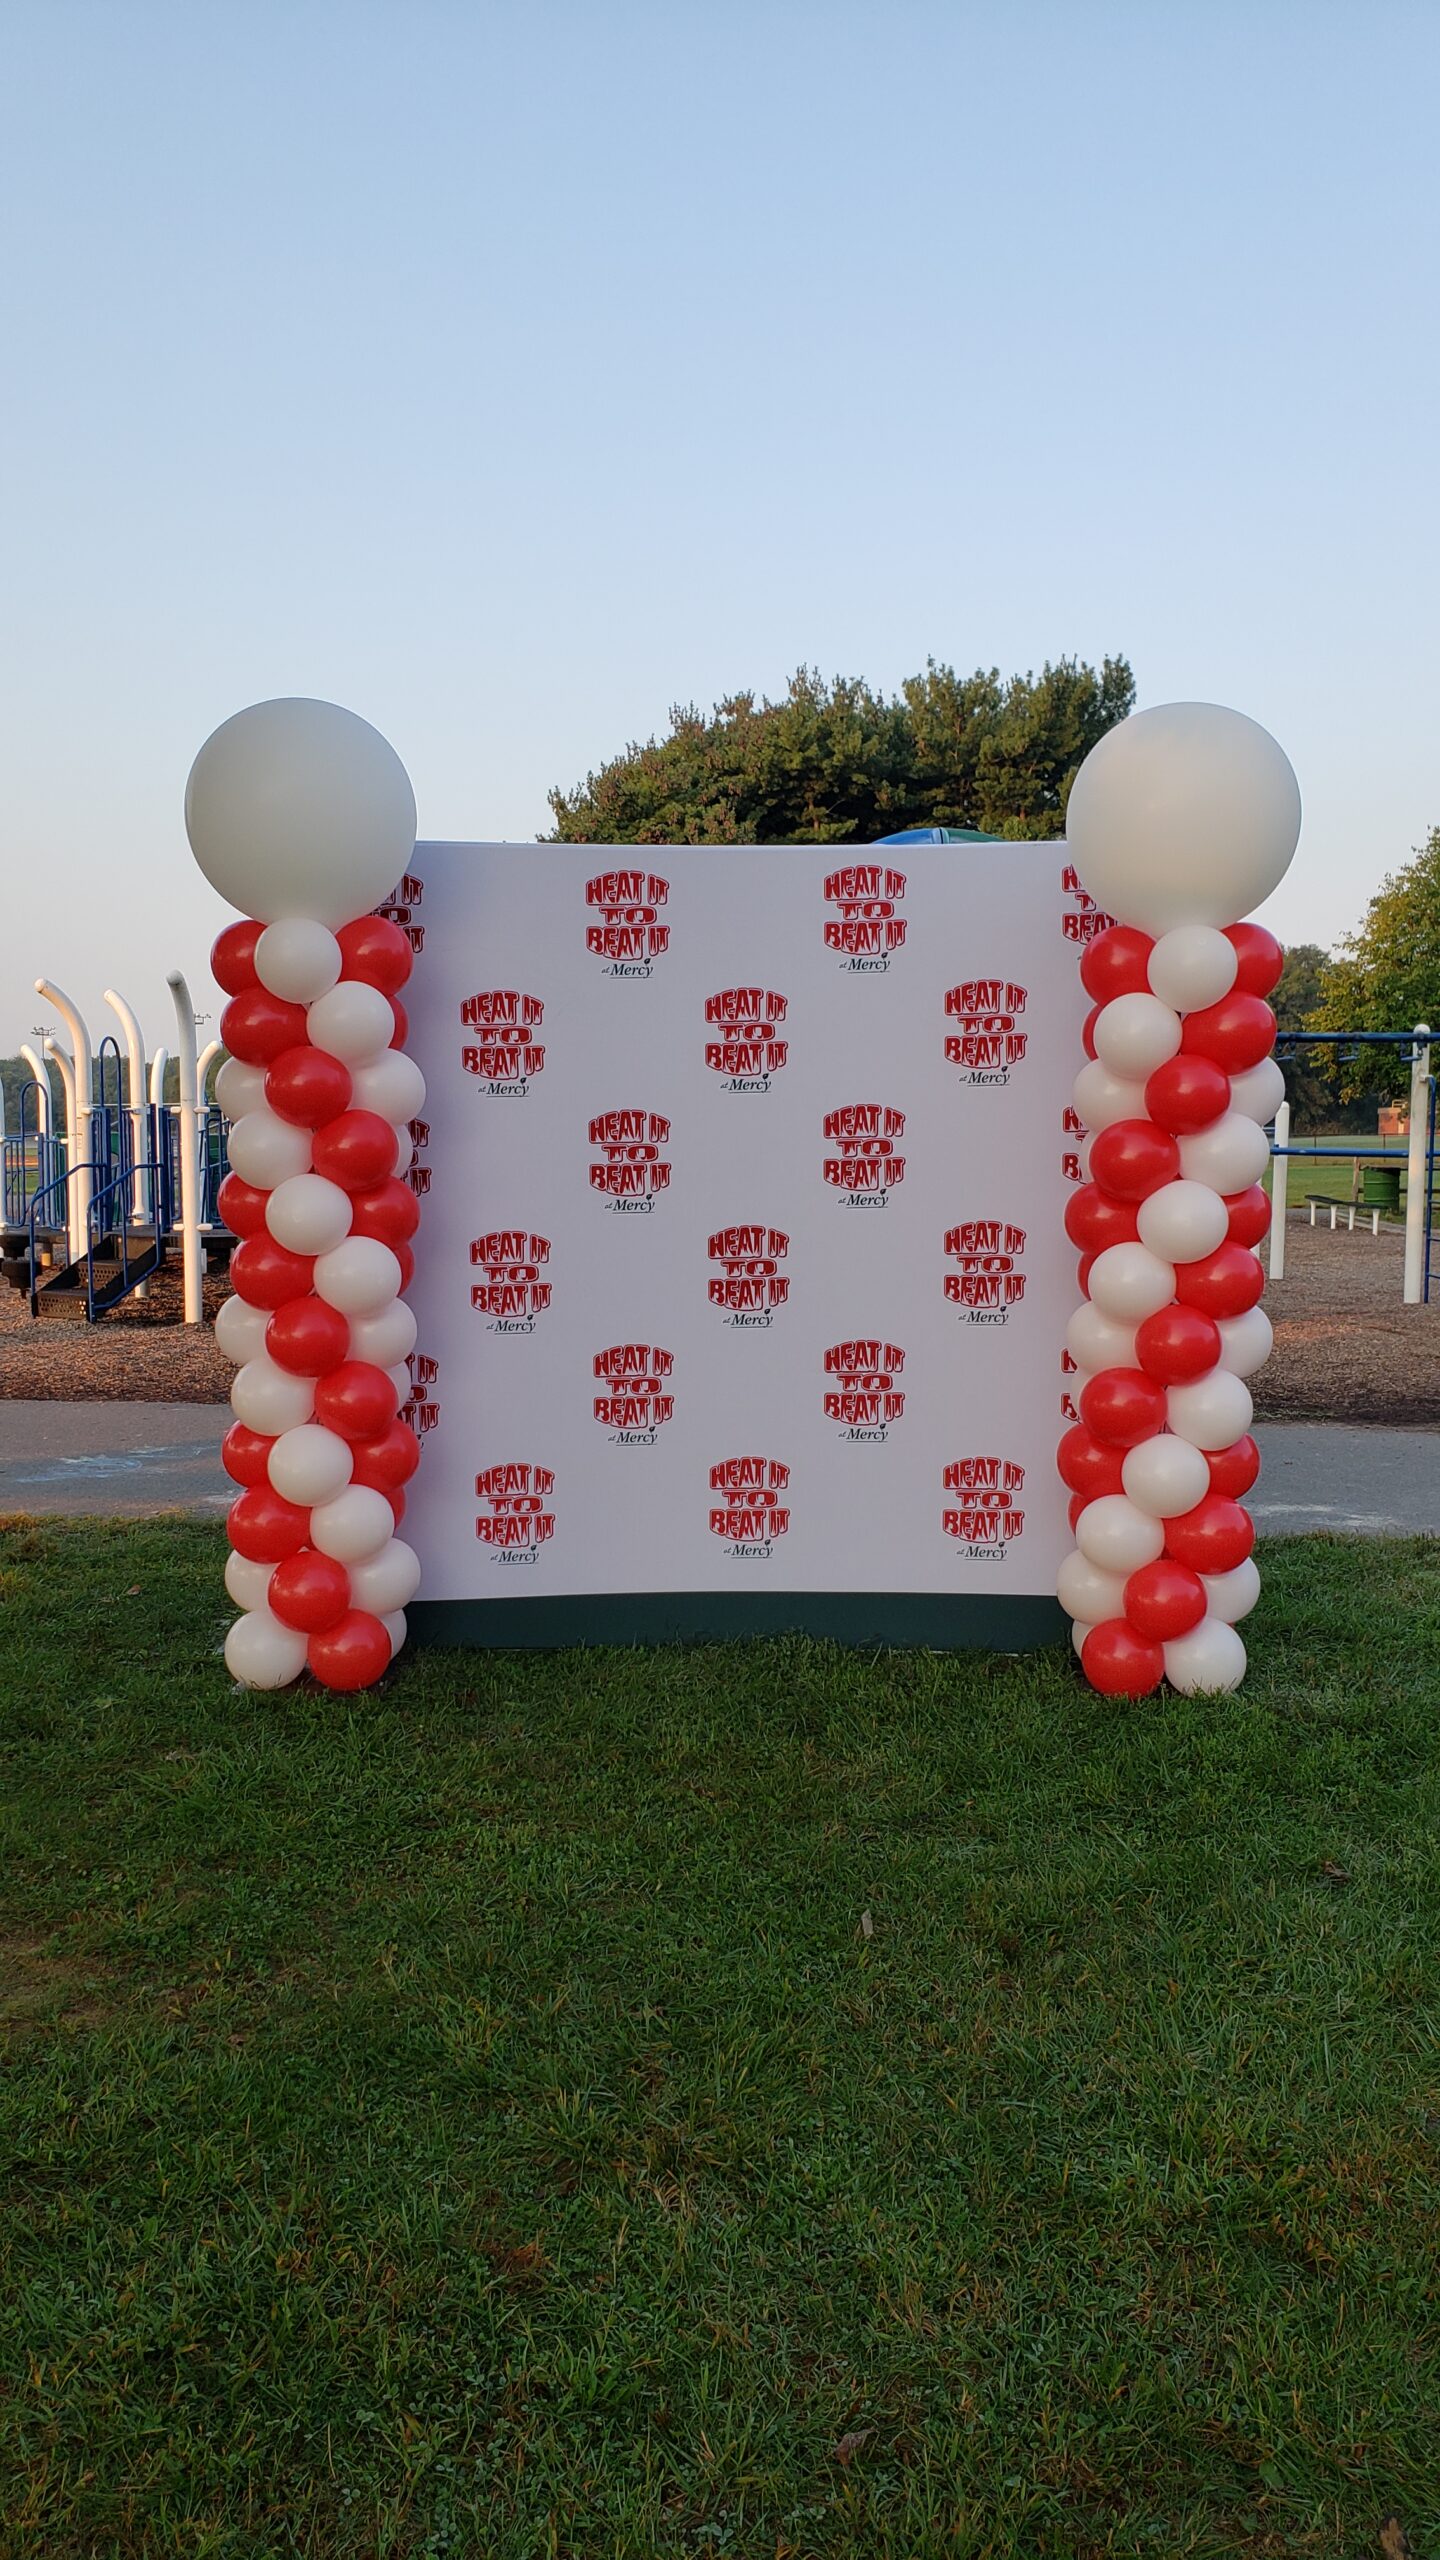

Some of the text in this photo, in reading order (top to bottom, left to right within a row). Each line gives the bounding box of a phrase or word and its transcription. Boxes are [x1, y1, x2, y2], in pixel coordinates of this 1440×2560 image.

[586, 870, 670, 906] HEAT IT
[824, 865, 906, 901] HEAT IT
[599, 906, 657, 925] TO
[837, 901, 894, 920] TO
[586, 925, 671, 960] BEAT IT
[824, 920, 907, 955] BEAT IT
[610, 964, 654, 977] Mercy
[847, 959, 890, 972] Mercy
[460, 991, 544, 1026] HEAT IT
[705, 987, 788, 1022] HEAT IT
[945, 980, 1027, 1015] HEAT IT
[473, 1027, 531, 1045] TO
[718, 1023, 776, 1041] TO
[958, 1015, 1015, 1034] TO
[460, 1046, 545, 1080] BEAT IT
[705, 1042, 789, 1076] BEAT IT
[945, 1034, 1028, 1068] BEAT IT
[486, 1084, 530, 1096] Mercy
[729, 1080, 772, 1092] Mercy
[967, 1072, 1010, 1084] Mercy
[589, 1109, 671, 1143] HEAT IT
[823, 1104, 905, 1138] HEAT IT
[602, 1144, 659, 1162] TO
[836, 1138, 893, 1156] TO
[589, 1163, 672, 1196] BEAT IT
[823, 1157, 906, 1190] BEAT IT
[612, 1199, 655, 1212] Mercy
[846, 1193, 889, 1206] Mercy
[470, 1231, 552, 1265] HEAT IT
[708, 1225, 789, 1259] HEAT IT
[945, 1221, 1026, 1255] HEAT IT
[483, 1265, 540, 1283] TO
[721, 1259, 777, 1277] TO
[958, 1255, 1014, 1273] TO
[470, 1284, 553, 1317] BEAT IT
[708, 1278, 790, 1311] BEAT IT
[945, 1274, 1027, 1307] BEAT IT
[493, 1320, 536, 1333] Mercy
[731, 1314, 774, 1327] Mercy
[967, 1310, 1010, 1323] Mercy
[418, 1355, 439, 1384] IT
[593, 1344, 674, 1378] HEAT IT
[823, 1339, 905, 1373] HEAT IT
[606, 1378, 662, 1396] TO
[836, 1373, 893, 1391] TO
[419, 1403, 440, 1432] IT
[593, 1396, 675, 1429] BEAT IT
[823, 1392, 906, 1425] BEAT IT
[616, 1432, 659, 1445] Mercy
[846, 1428, 889, 1441] Mercy
[475, 1463, 555, 1496] HEAT IT
[709, 1456, 789, 1490] HEAT IT
[943, 1457, 1025, 1491] HEAT IT
[487, 1497, 543, 1514] TO
[721, 1490, 777, 1508] TO
[956, 1491, 1013, 1509] TO
[475, 1515, 556, 1547] BEAT IT
[709, 1508, 790, 1541] BEAT IT
[943, 1509, 1026, 1542] BEAT IT
[498, 1550, 540, 1563] Mercy
[732, 1544, 774, 1557] Mercy
[965, 1545, 1008, 1558] Mercy
